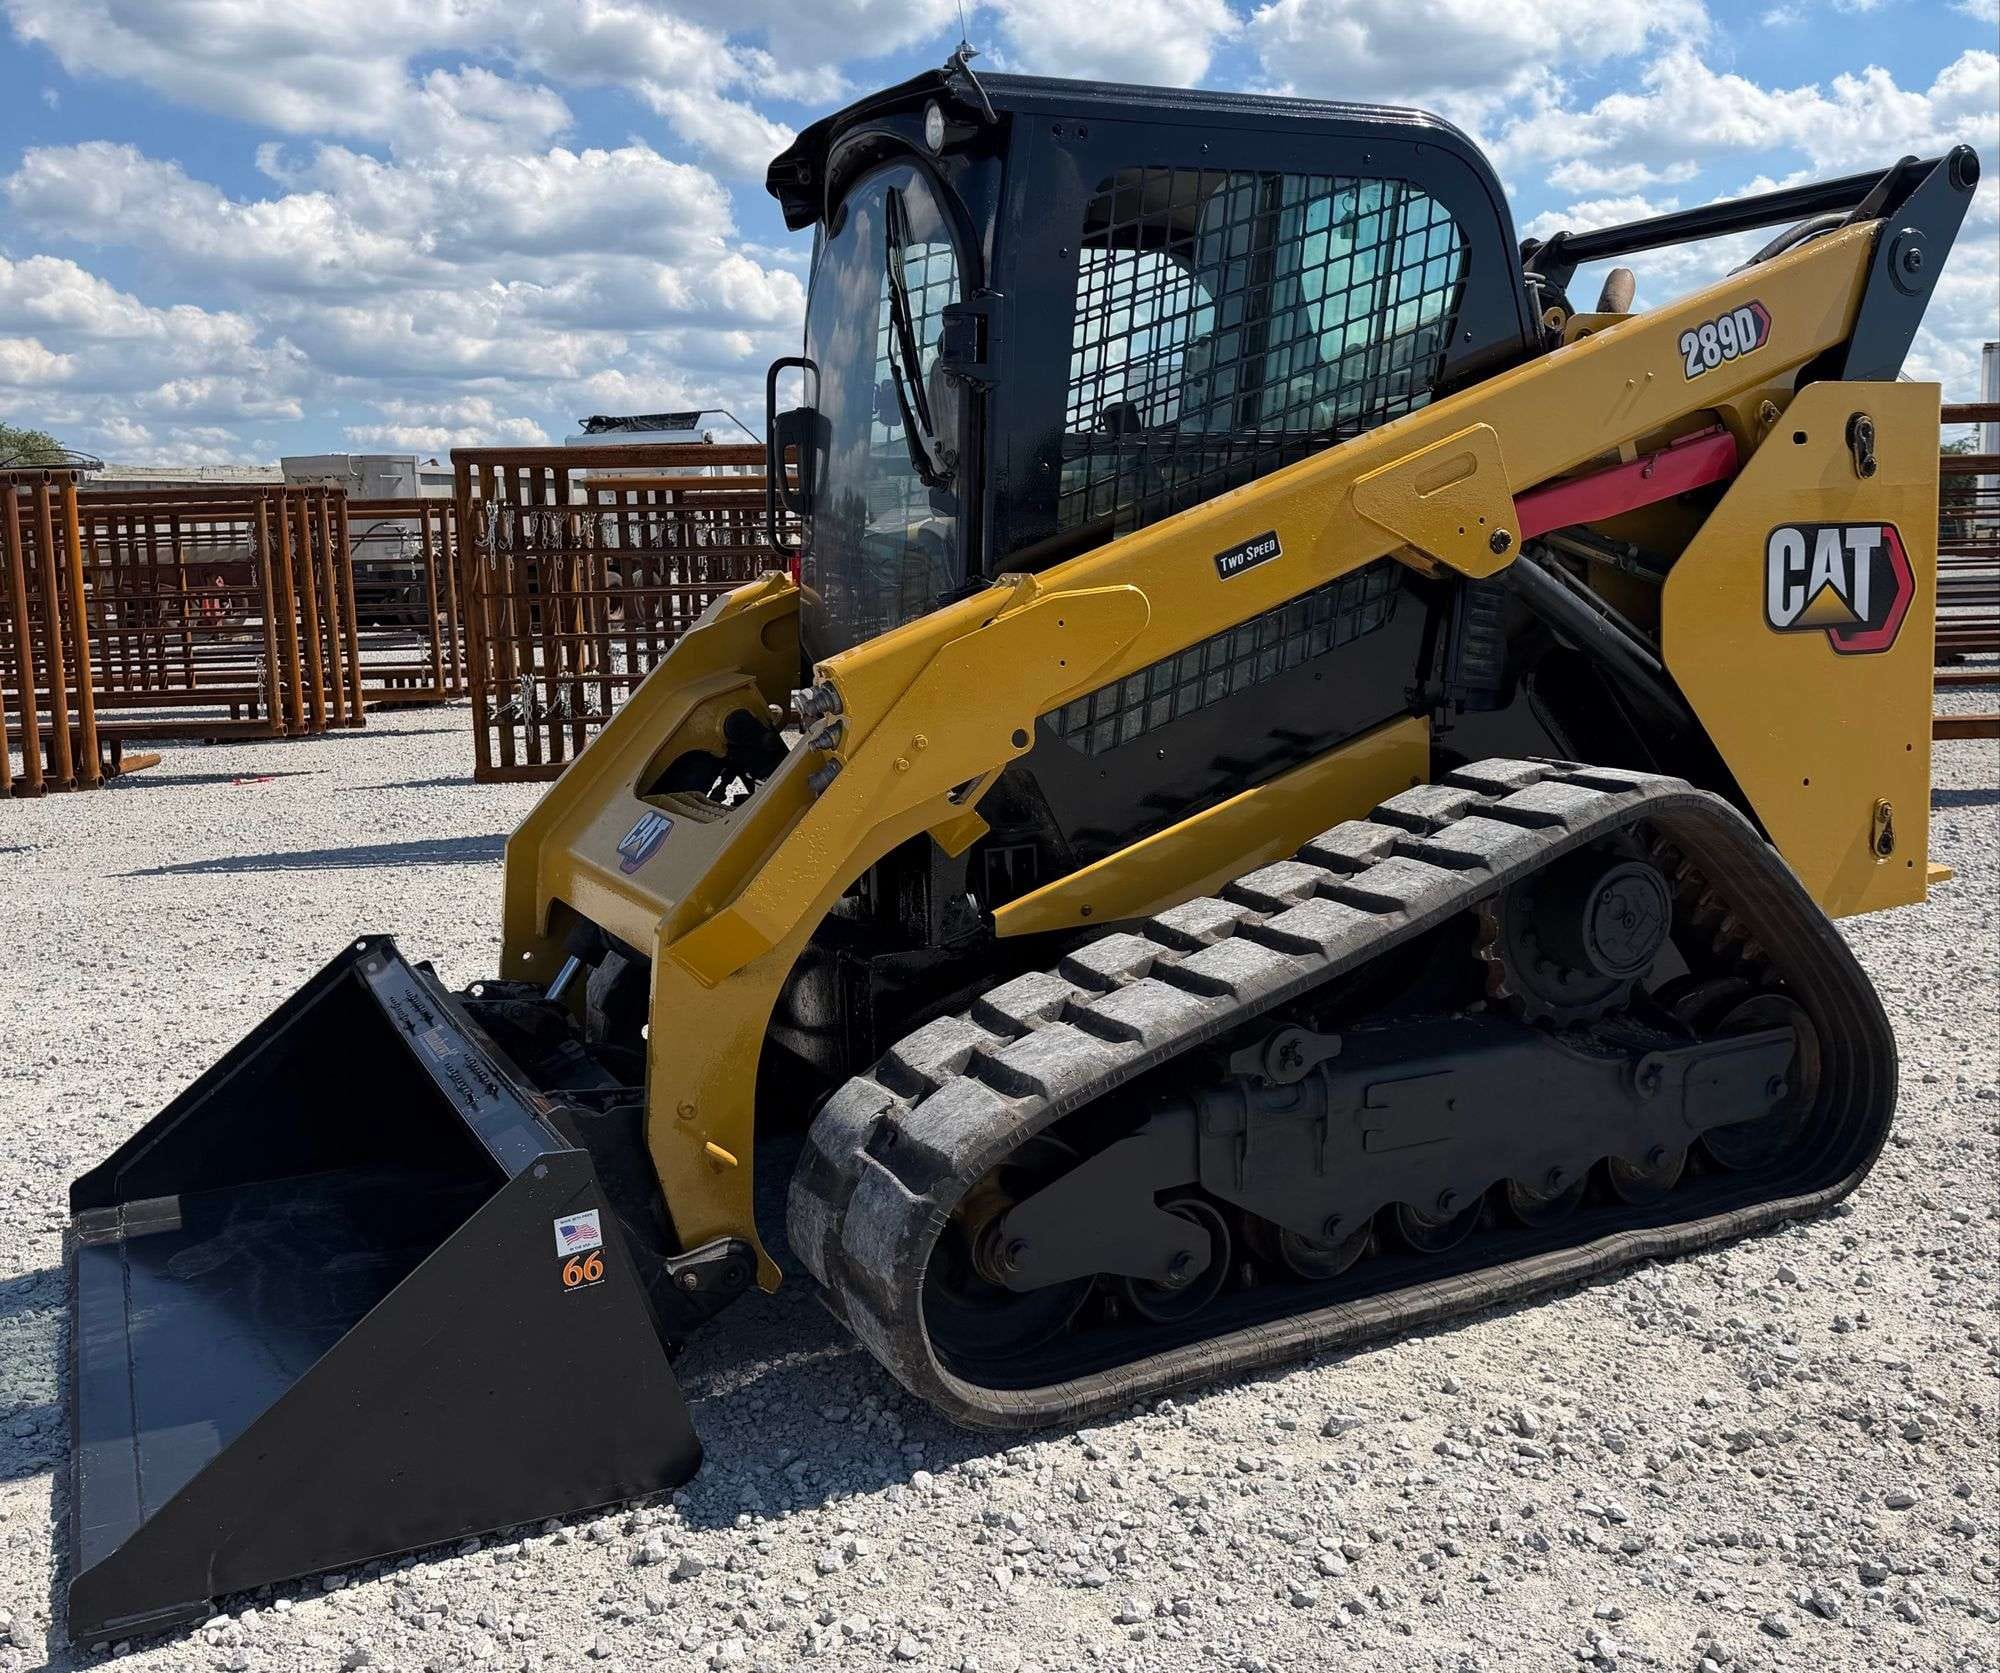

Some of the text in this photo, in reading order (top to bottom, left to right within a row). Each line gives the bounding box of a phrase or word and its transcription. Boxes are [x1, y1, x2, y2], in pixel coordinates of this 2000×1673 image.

[1680, 307, 1758, 378] 289D
[1219, 539, 1276, 572] TWO SPEED
[1768, 526, 1882, 628] CAT
[618, 811, 672, 860] CAT
[562, 1250, 603, 1286] 66
